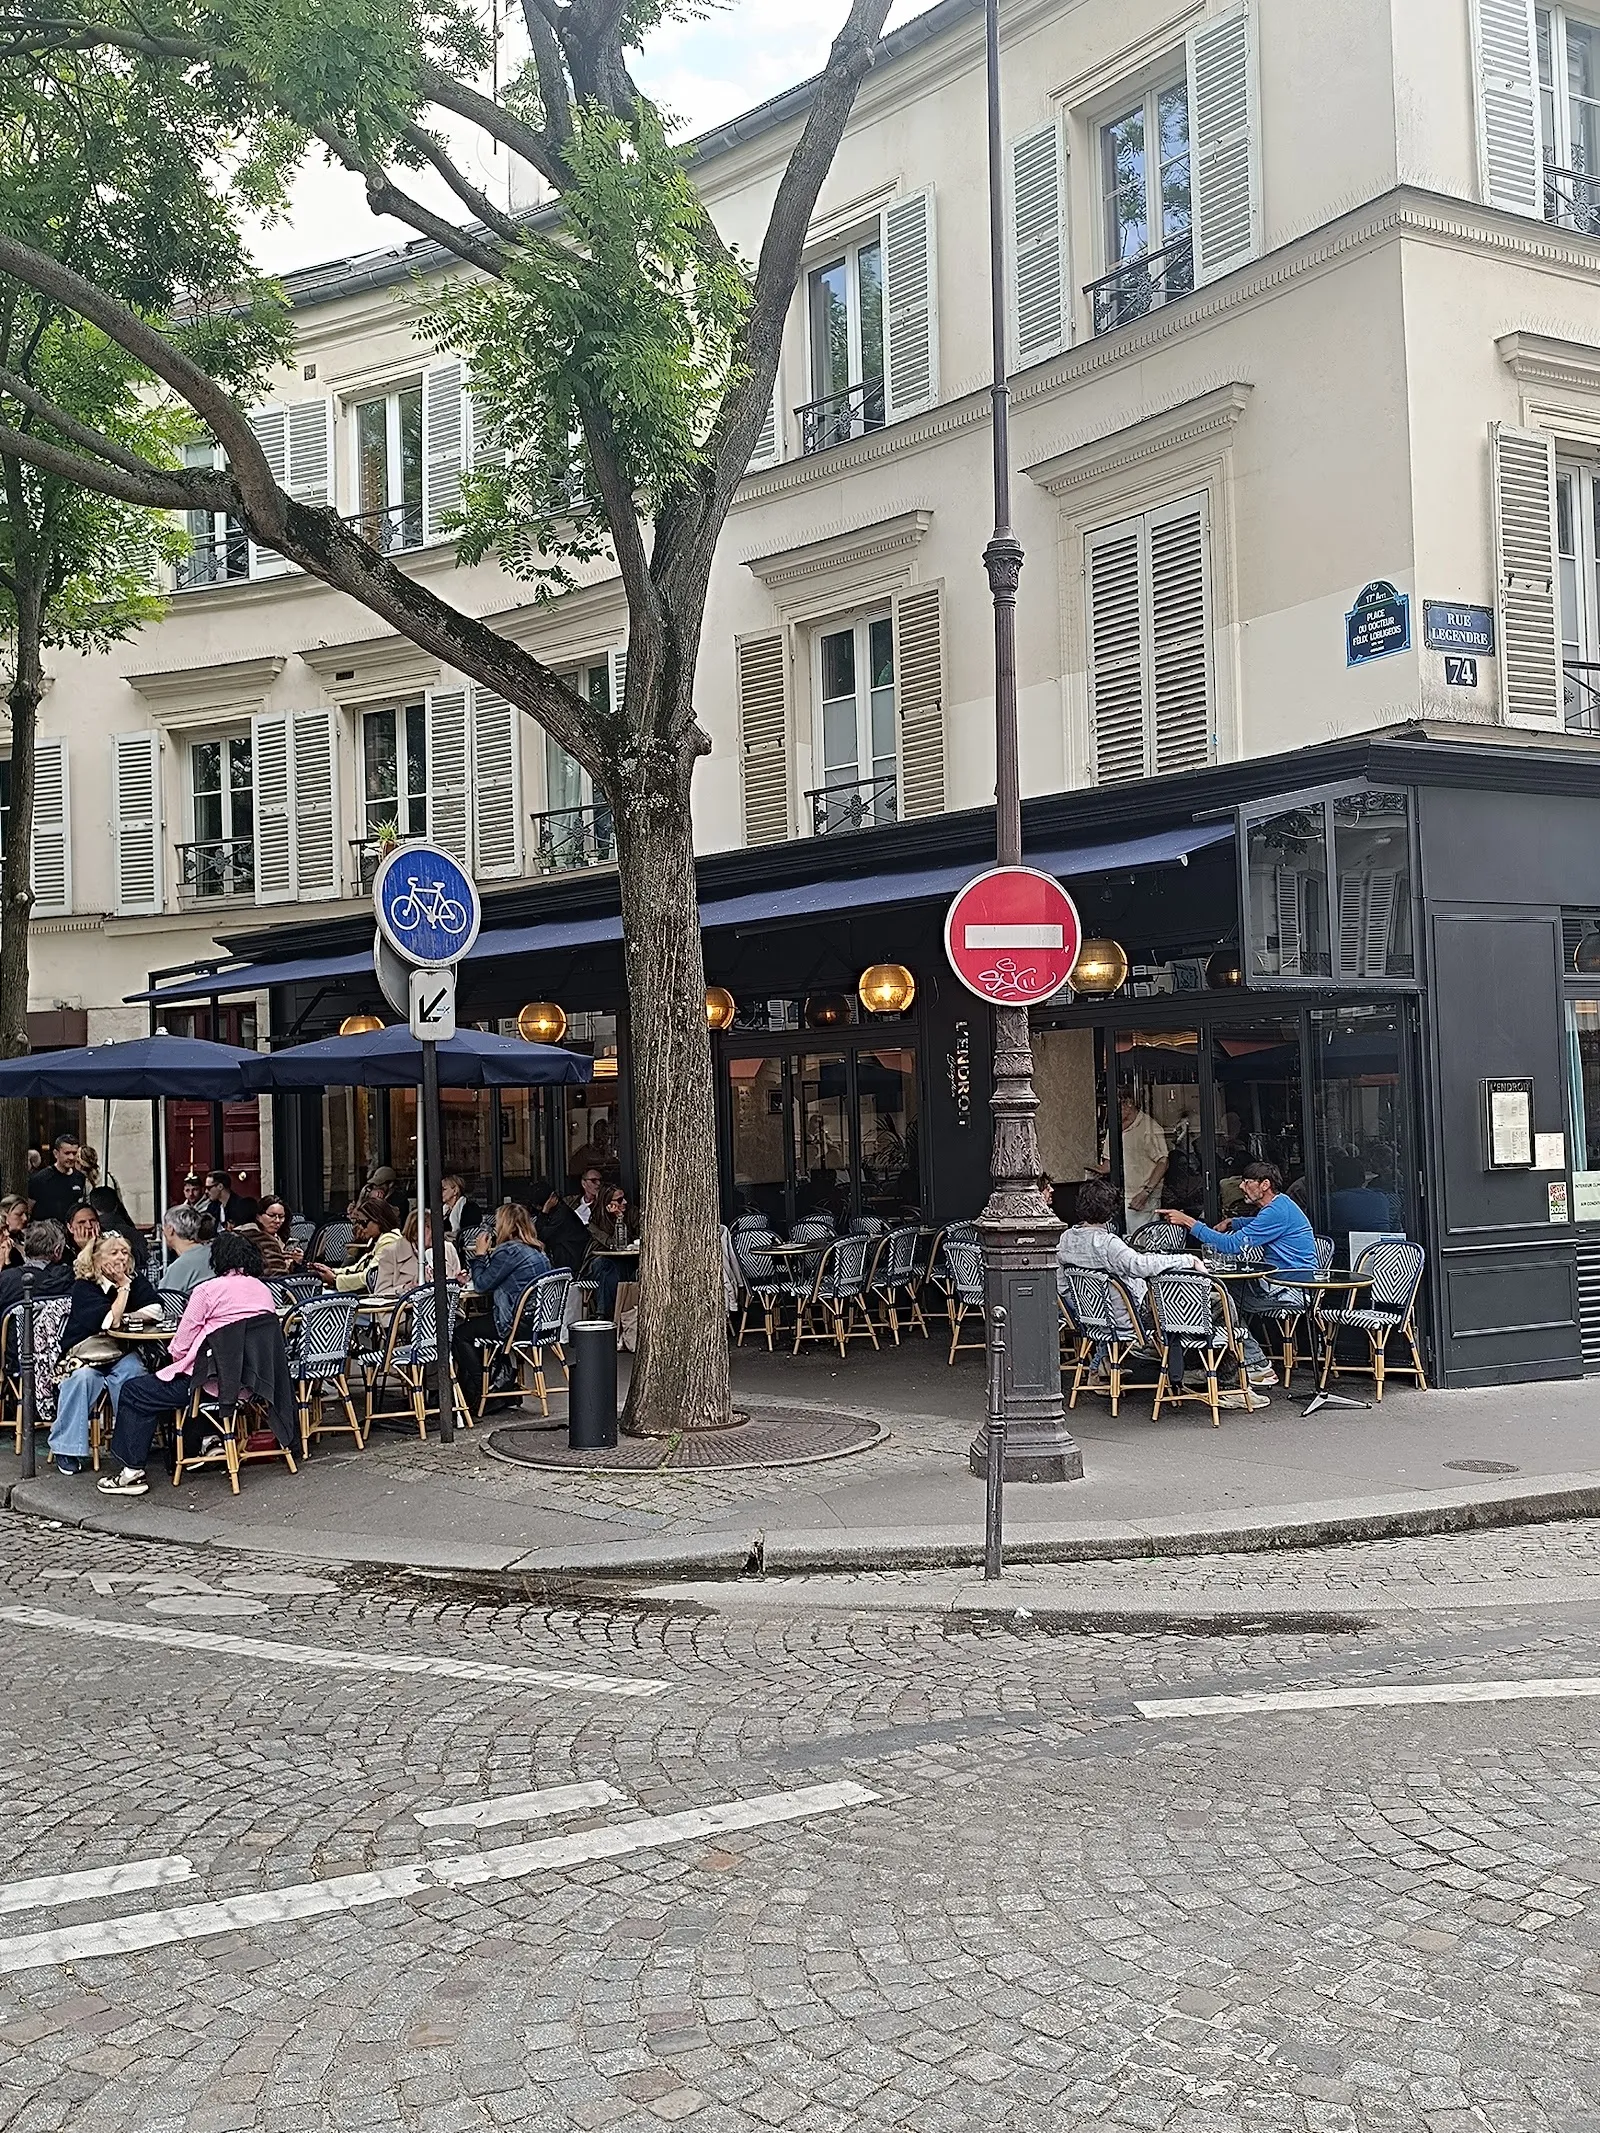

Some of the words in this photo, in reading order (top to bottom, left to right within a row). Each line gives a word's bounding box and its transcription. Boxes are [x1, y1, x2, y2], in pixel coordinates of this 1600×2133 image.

[1366, 608, 1386, 622] PLACE
[1447, 613, 1472, 627] RUE
[1358, 624, 1367, 634] DU
[1368, 616, 1395, 631] DOCTEUR
[1431, 627, 1488, 645] LEGENDRE
[1449, 659, 1474, 684] 74
[955, 1021, 971, 1129] L'ENDROIT
